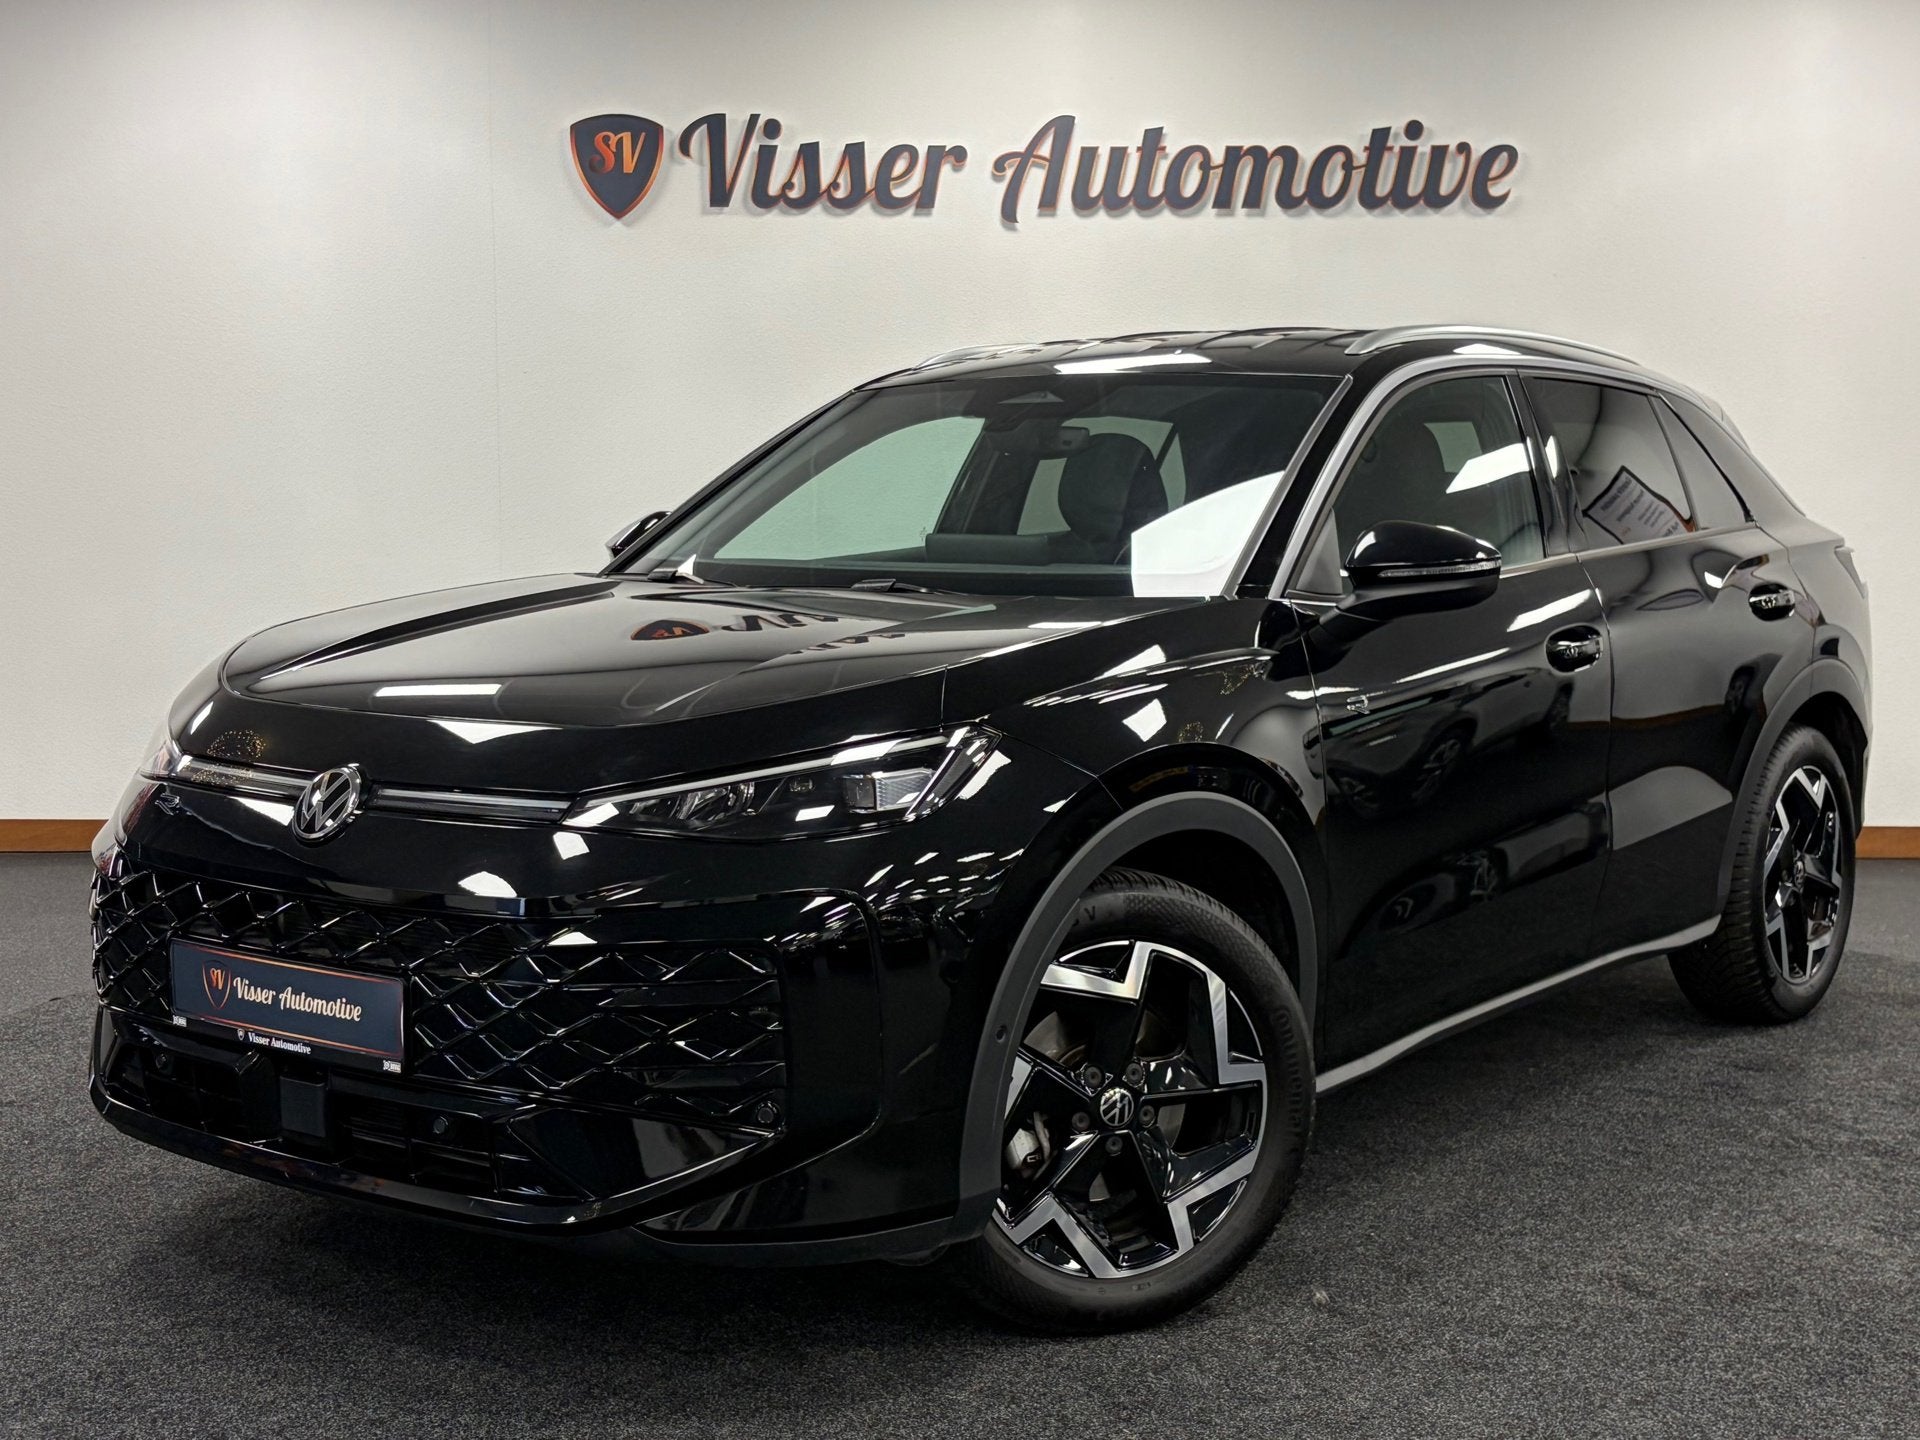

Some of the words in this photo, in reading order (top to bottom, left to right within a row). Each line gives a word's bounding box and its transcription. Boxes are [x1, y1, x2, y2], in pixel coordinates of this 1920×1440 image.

[588, 131, 646, 174] SV
[678, 112, 968, 210] Visser
[991, 114, 1519, 224] Automotive
[233, 976, 276, 1005] Visser
[279, 986, 362, 1022] Automotive
[247, 1031, 271, 1046] Visser
[271, 1037, 312, 1055] Automotive
